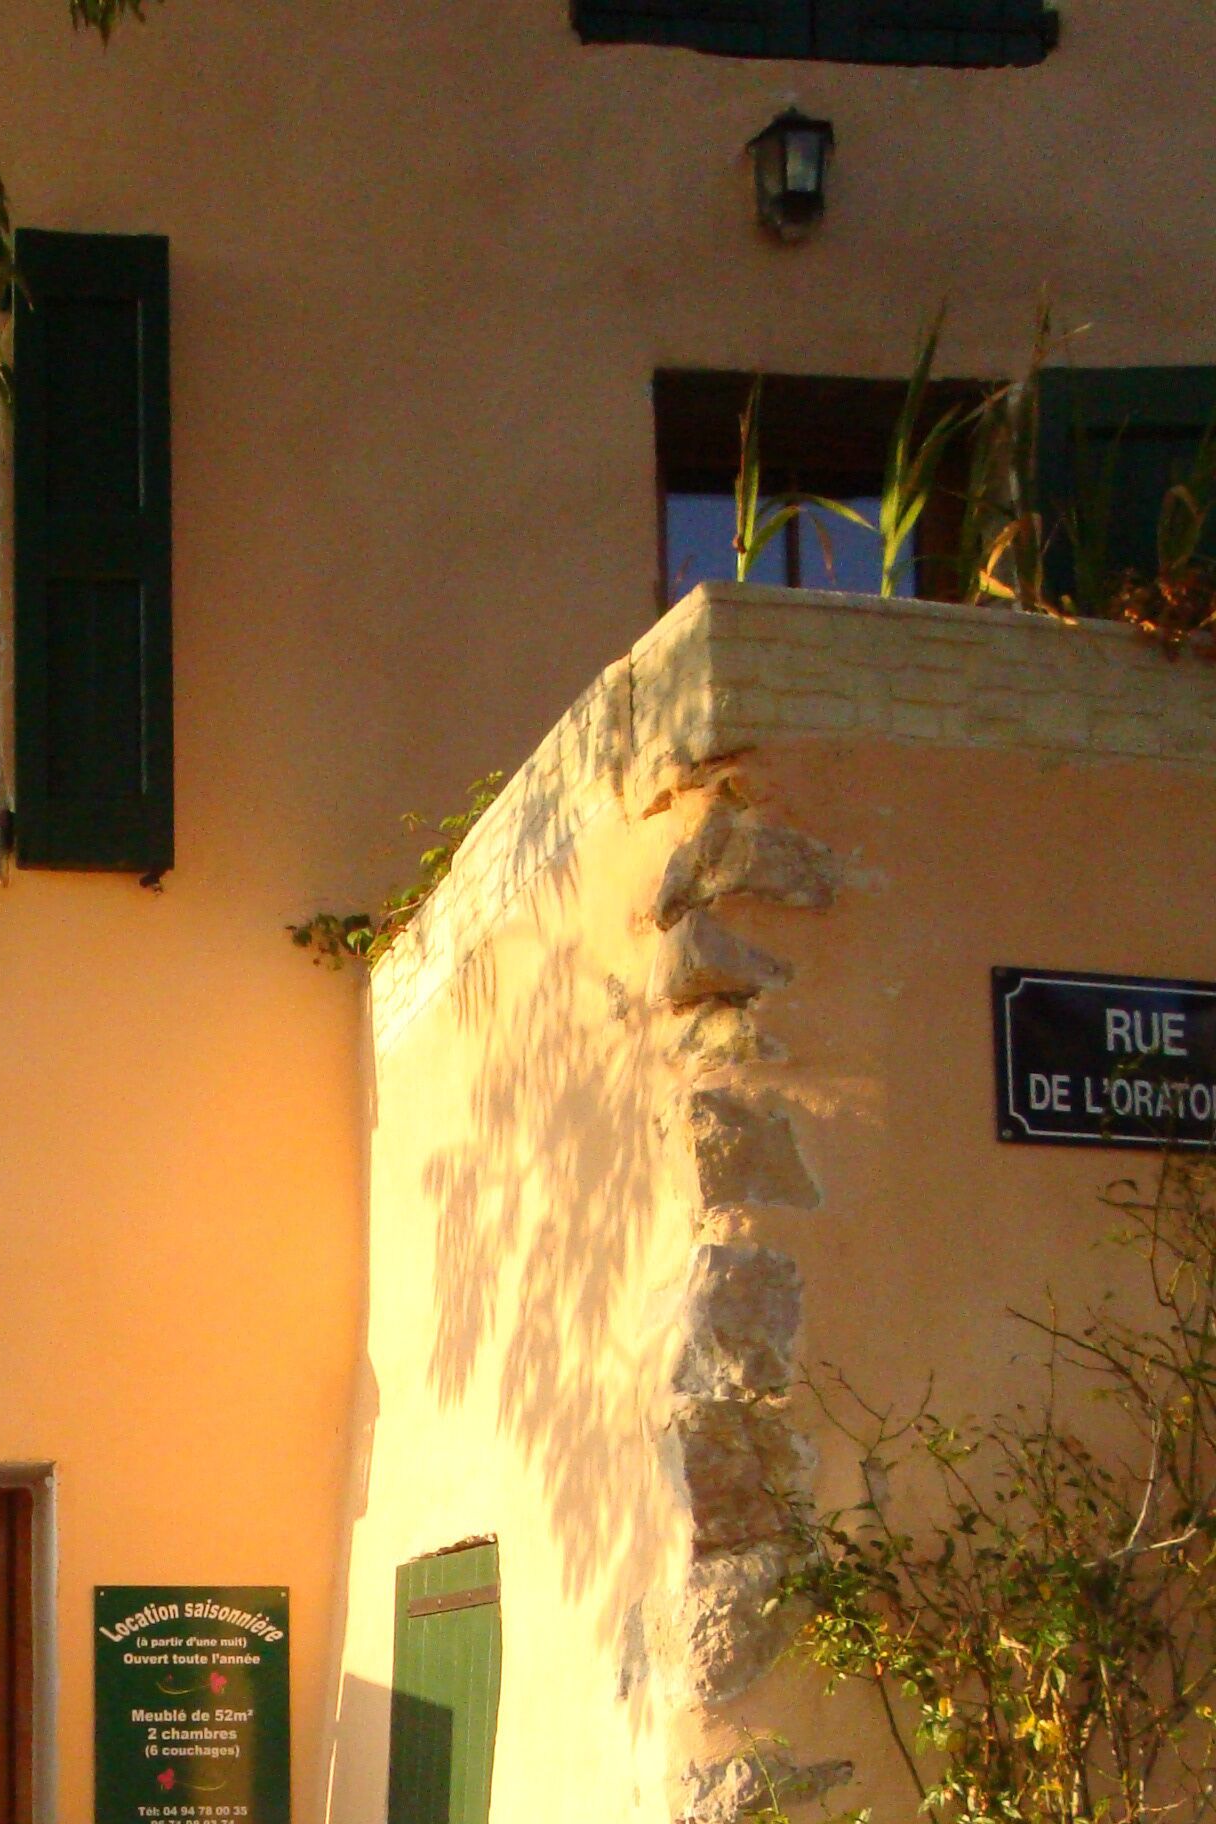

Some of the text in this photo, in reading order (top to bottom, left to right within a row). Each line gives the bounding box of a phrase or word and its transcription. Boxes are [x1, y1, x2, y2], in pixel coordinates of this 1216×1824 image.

[1105, 1008, 1188, 1057] RUE
[1029, 1073, 1072, 1112] DE
[99, 1599, 284, 1642] Location saisonnière
[136, 1637, 247, 1648] (à partir d'une nuit)
[123, 1653, 261, 1665] Ouvert toute l'année
[131, 1709, 187, 1722] Meublé
[191, 1709, 210, 1722] de
[147, 1727, 238, 1740] 2 chambres
[145, 1745, 240, 1758] (6 couchages)
[163, 1806, 178, 1816] 04
[180, 1806, 195, 1816] 94
[215, 1806, 230, 1816] 00
